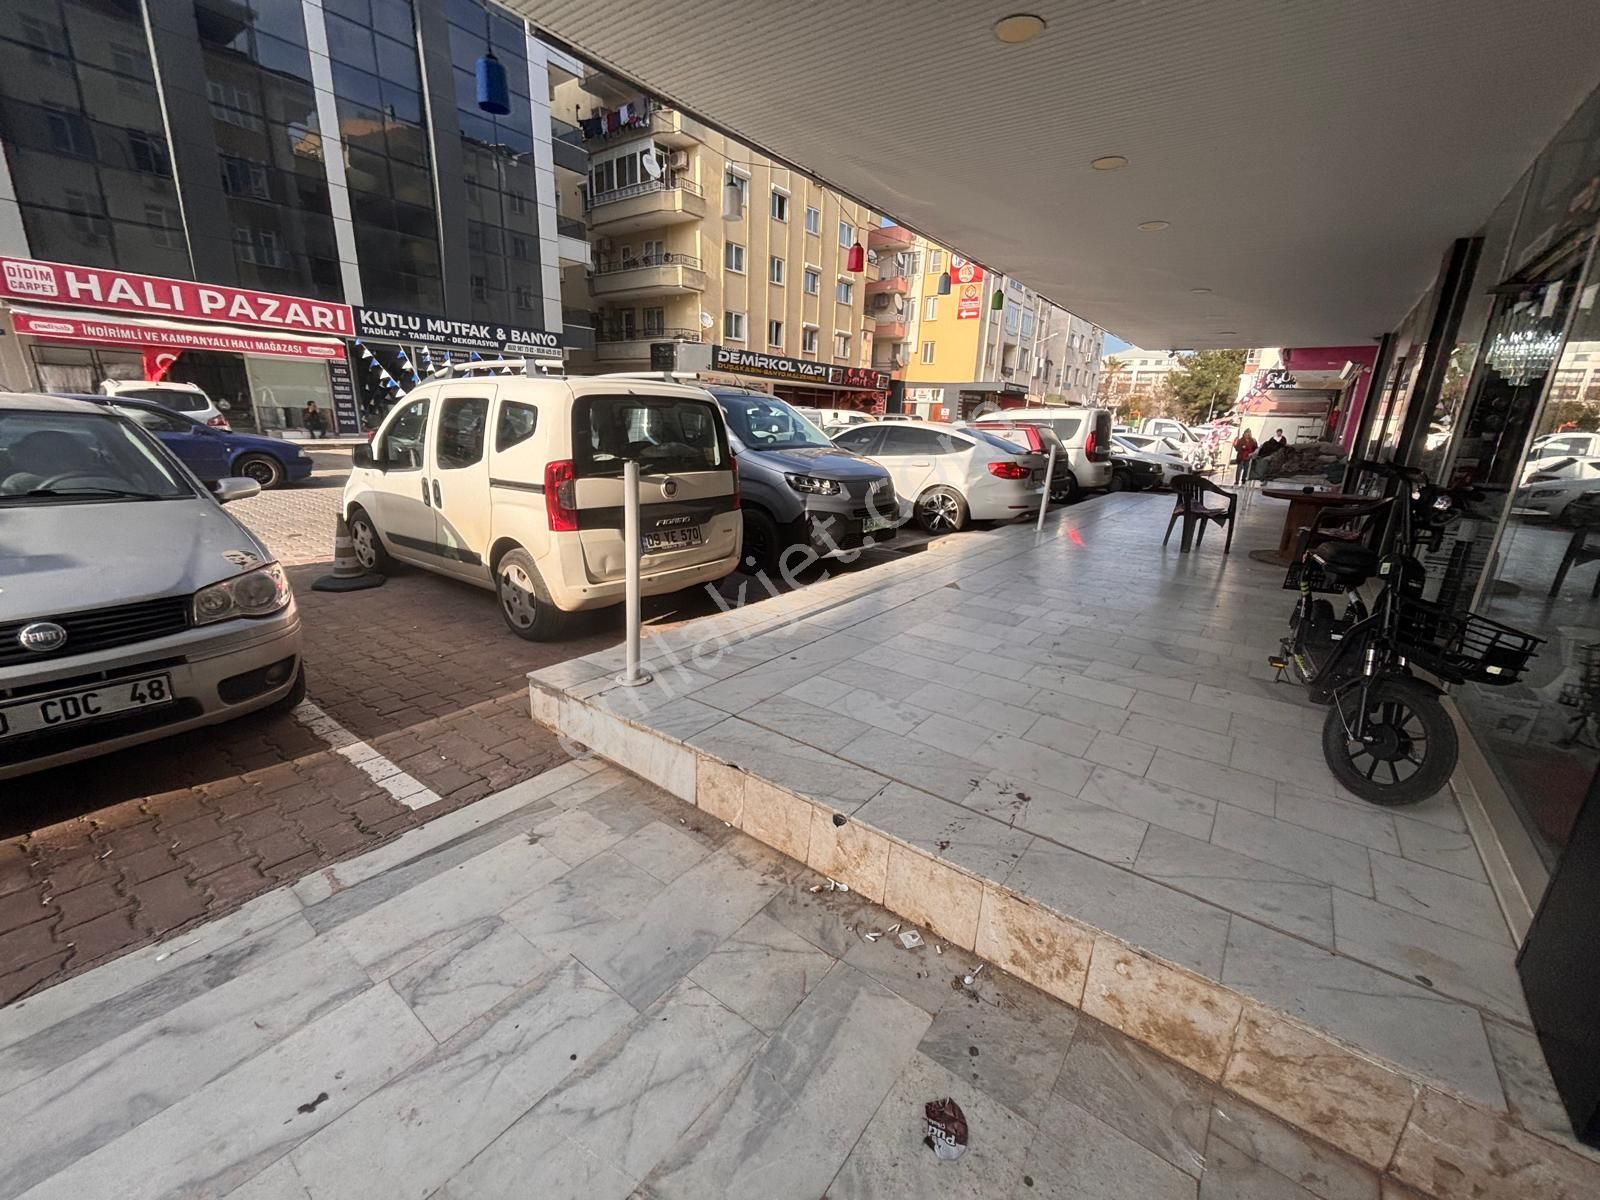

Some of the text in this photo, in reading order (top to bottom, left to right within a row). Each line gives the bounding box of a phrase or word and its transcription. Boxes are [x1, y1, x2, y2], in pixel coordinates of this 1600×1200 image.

[6, 265, 52, 282] DİDİM
[10, 280, 55, 293] CARPET
[65, 271, 346, 330] HALI PAZARI
[82, 323, 142, 340] İNDİRİMLİ
[144, 331, 159, 341] VE
[160, 332, 229, 347] KAMPANYALI
[231, 338, 254, 350] HALI
[255, 341, 303, 354] MAĞAZASI
[360, 309, 557, 346] KUTLU MUTFAK & BANYO
[362, 326, 400, 337] TADİLAT
[408, 332, 445, 342] TAMİRAT
[452, 336, 499, 348] DEKORASYON
[718, 351, 826, 377] DEMİRKOL YAPI
[647, 533, 661, 547] 09
[664, 531, 677, 543] YE
[681, 528, 698, 541] 570
[28, 630, 58, 643] FIAT
[40, 692, 102, 725] CDC
[130, 679, 166, 704] 48
